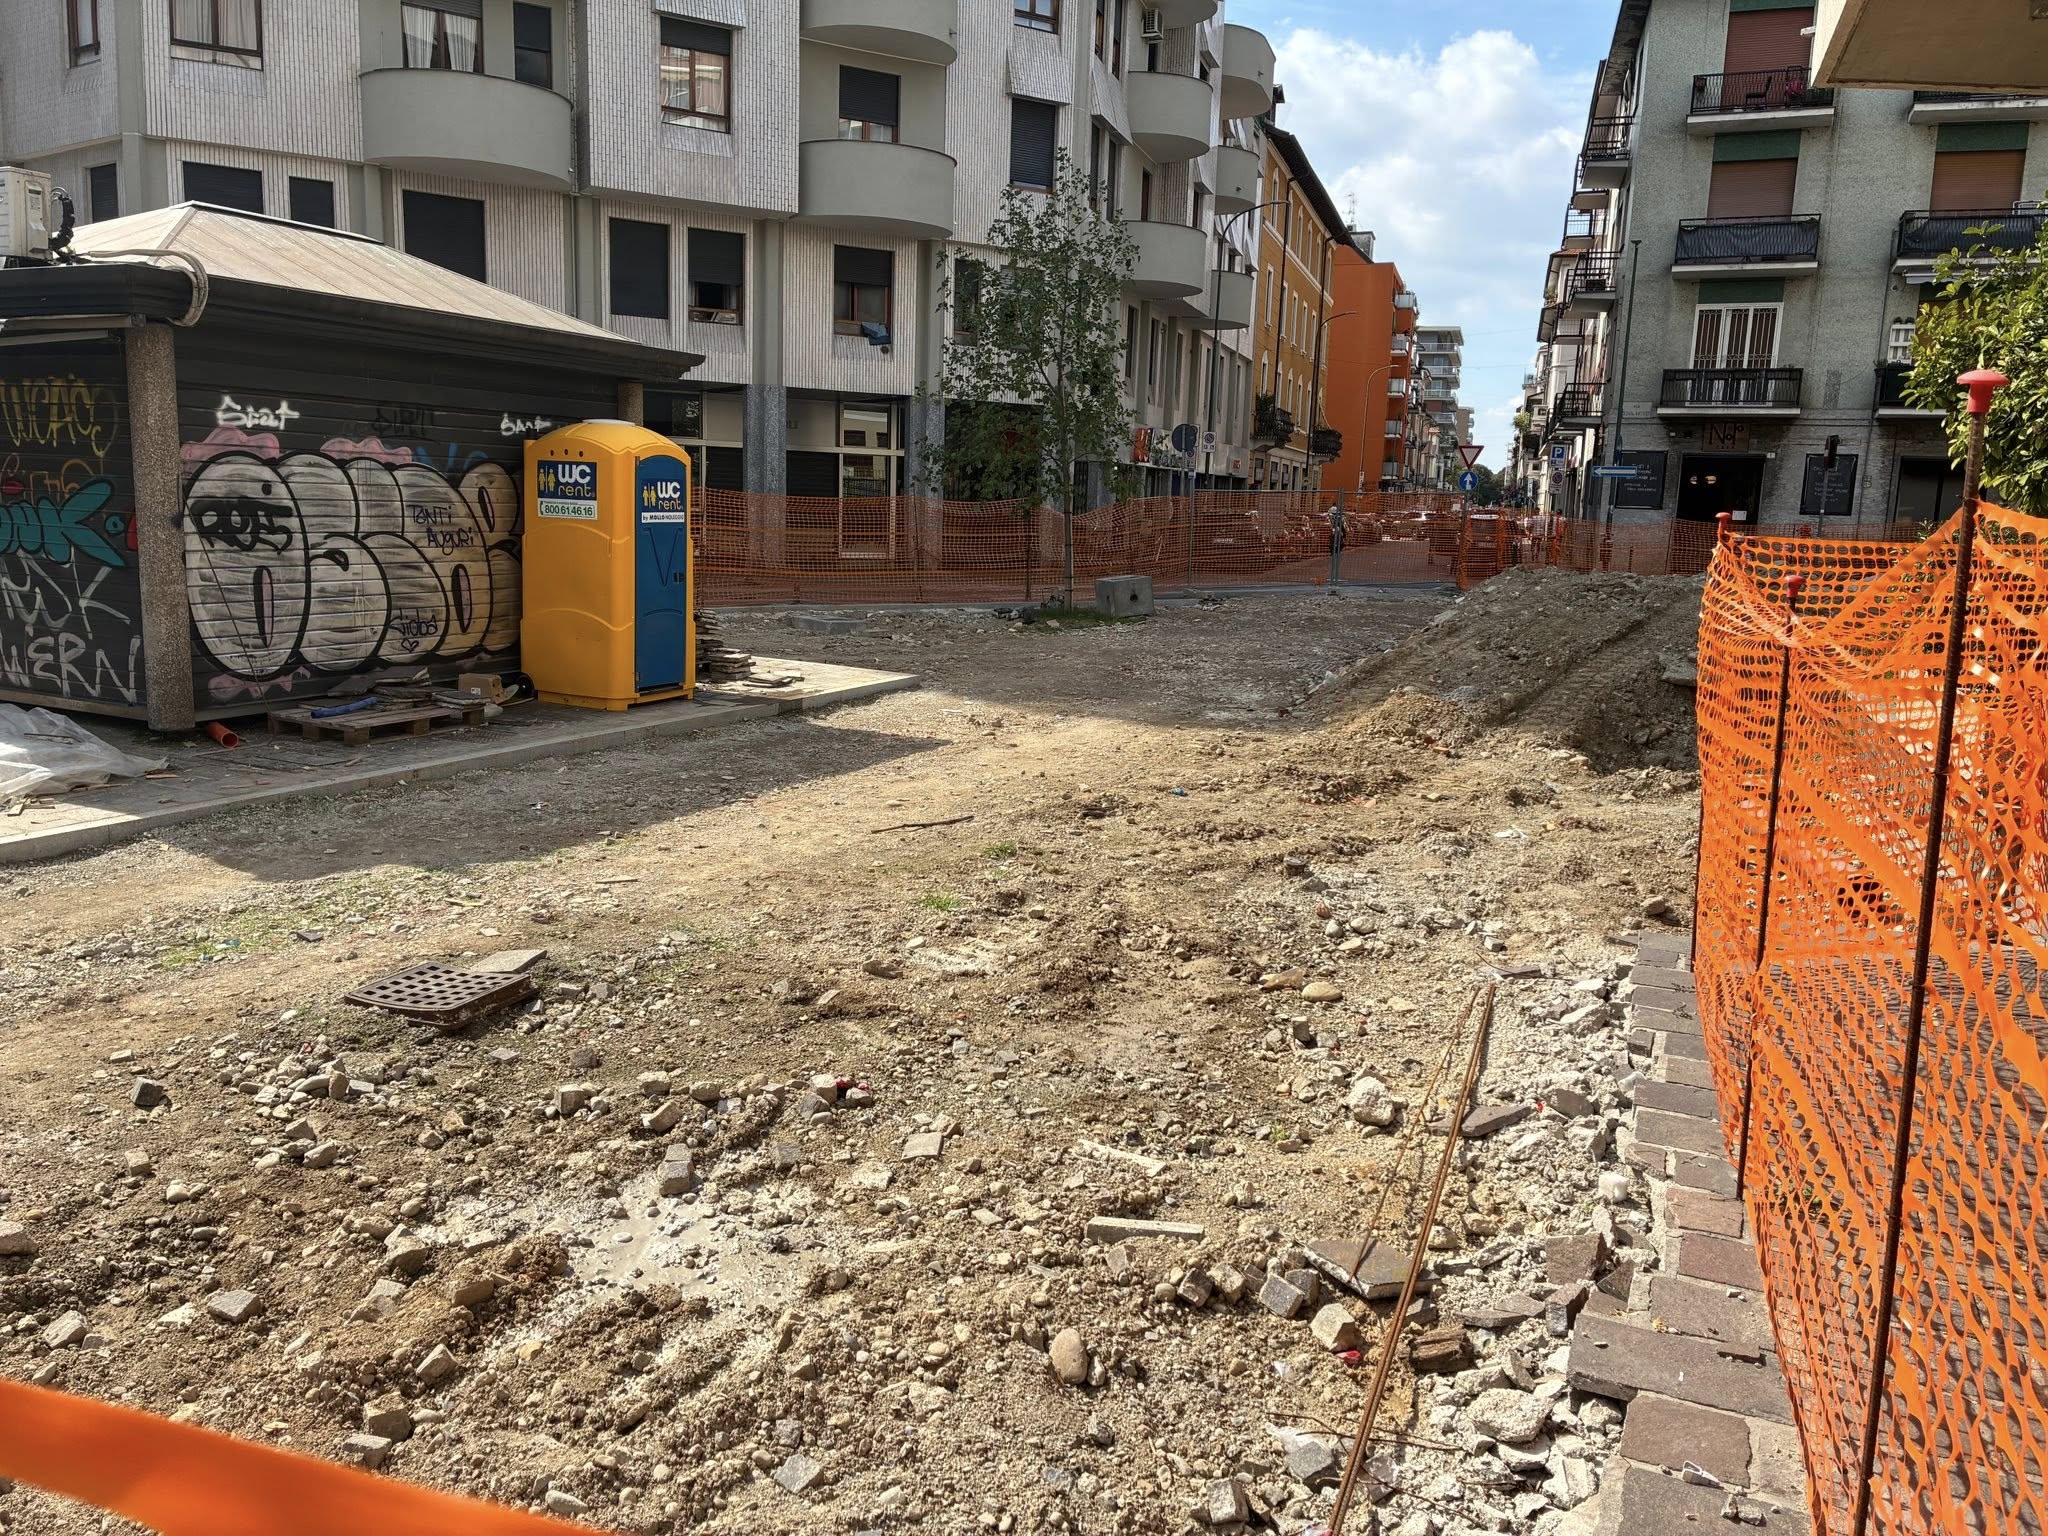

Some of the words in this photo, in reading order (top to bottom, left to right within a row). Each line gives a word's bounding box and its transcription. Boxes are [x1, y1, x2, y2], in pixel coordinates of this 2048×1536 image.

[1554, 447, 1562, 457] P
[558, 464, 591, 483] WC
[558, 484, 591, 497] rent
[657, 481, 680, 498] WC
[658, 499, 681, 510] rent
